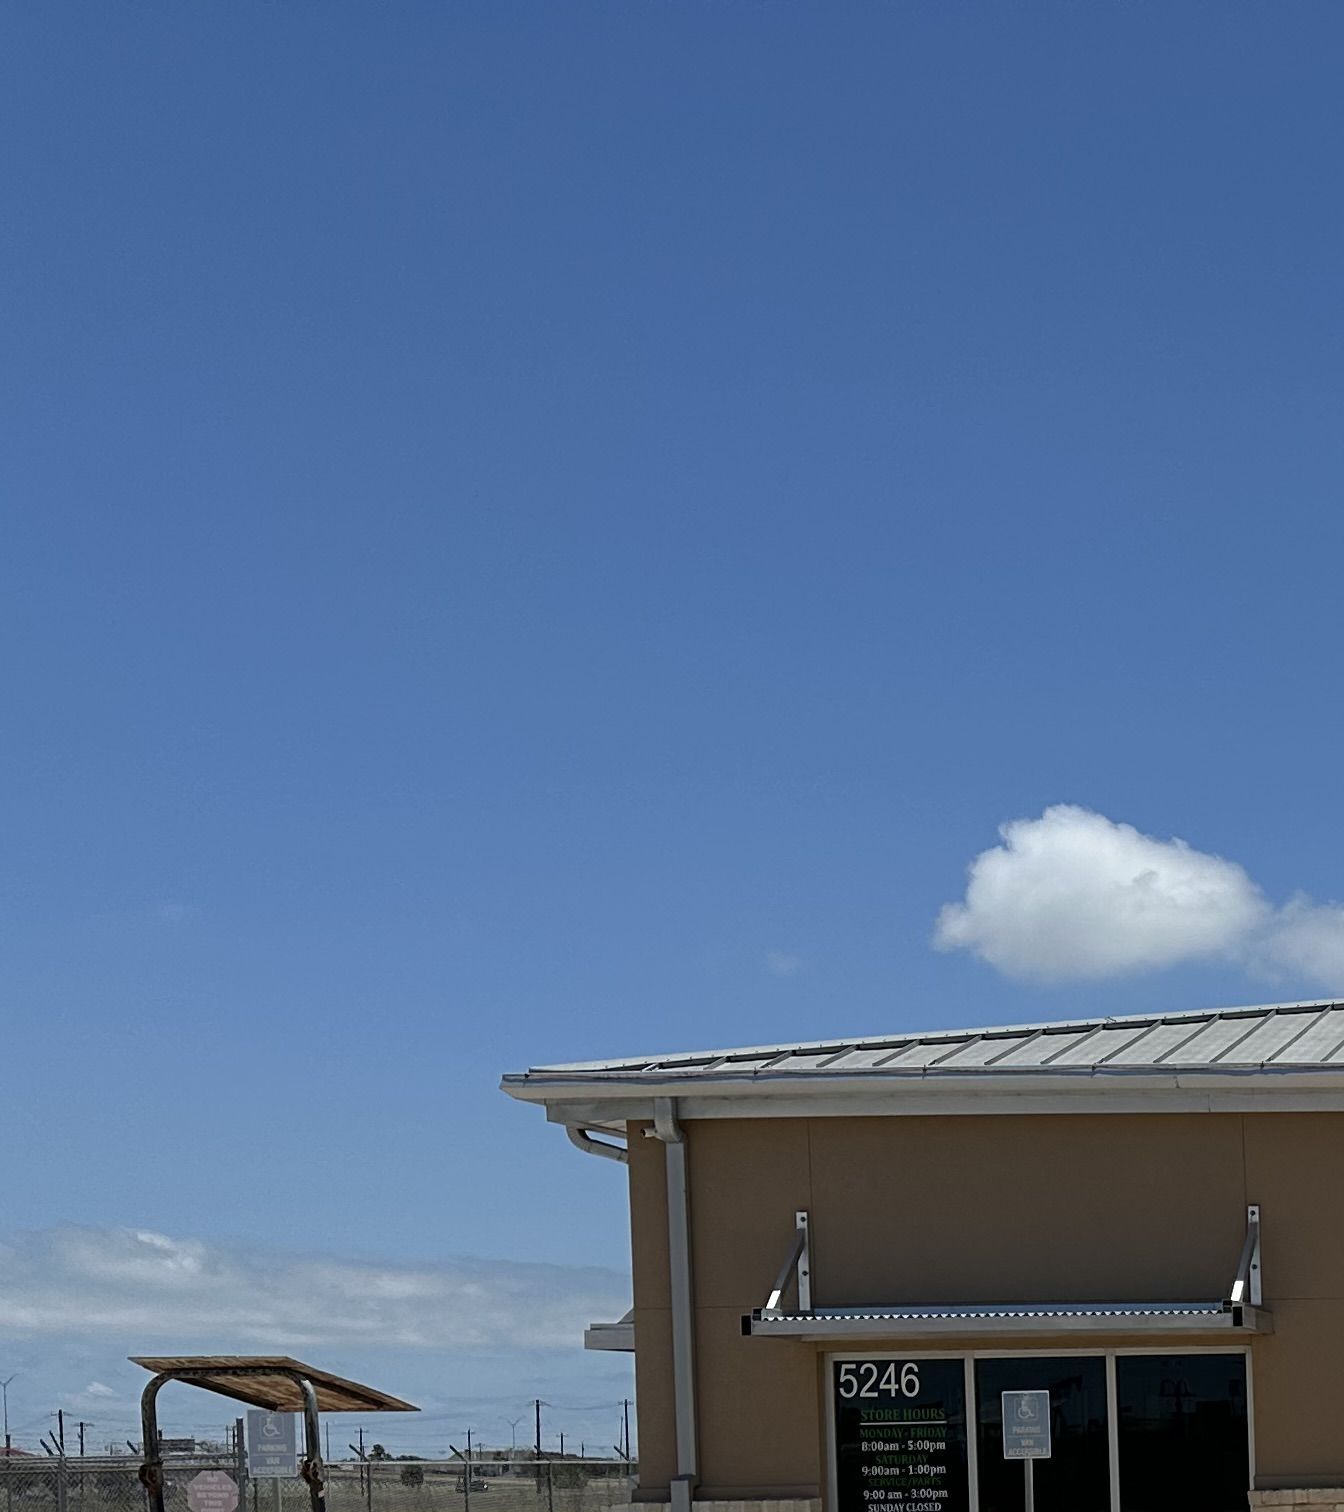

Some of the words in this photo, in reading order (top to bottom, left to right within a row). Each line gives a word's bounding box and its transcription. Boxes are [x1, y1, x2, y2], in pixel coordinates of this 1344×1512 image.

[839, 1361, 921, 1399] 5246
[860, 1408, 900, 1421] STORE
[903, 1407, 946, 1420] HOURS
[859, 1427, 904, 1439] MONDAY
[910, 1426, 947, 1438] FRIDAY
[861, 1441, 900, 1452] 8:00am
[907, 1439, 946, 1453] 5:00pm
[875, 1454, 929, 1465] SATURDAY
[861, 1465, 900, 1476] 9:00am
[908, 1464, 947, 1477] 1:00pm
[862, 1489, 886, 1501] 9:00
[887, 1491, 903, 1500] am
[910, 1488, 949, 1501] 3:00pm
[867, 1503, 905, 1512] SUNDAY
[906, 1502, 942, 1512] CLOSED
